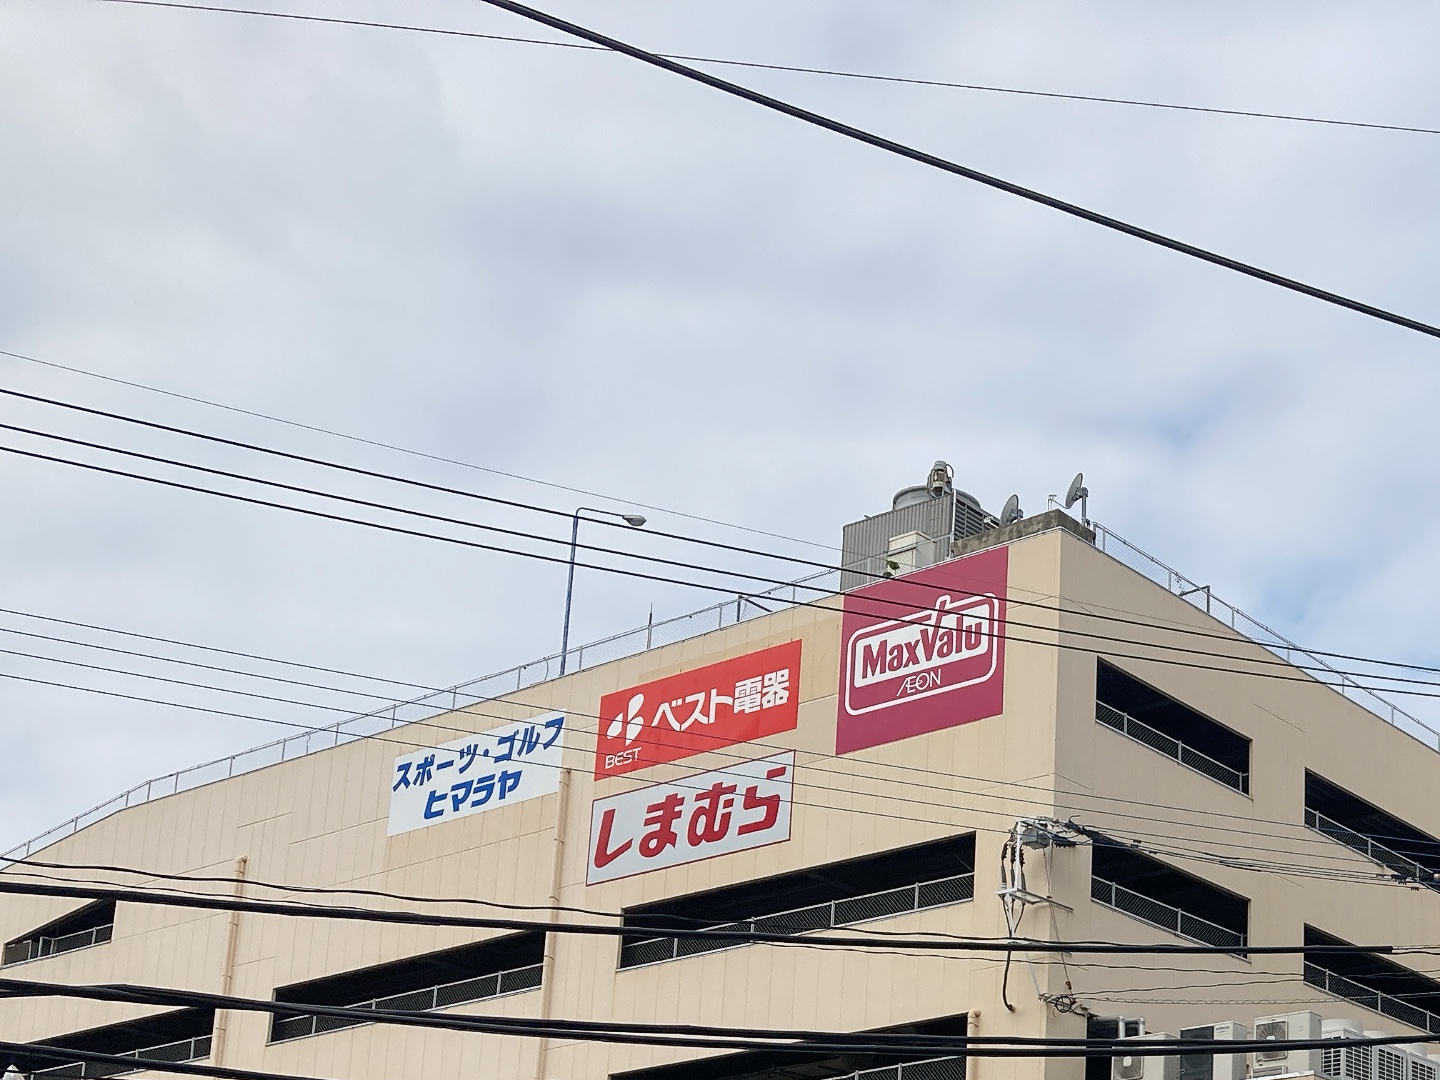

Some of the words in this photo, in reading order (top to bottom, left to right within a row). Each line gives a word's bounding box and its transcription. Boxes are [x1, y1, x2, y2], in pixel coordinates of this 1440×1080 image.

[862, 599, 983, 680] MaxValu
[651, 668, 790, 732] ベスト電器
[392, 716, 566, 792] スポーツ・ゴルフ
[604, 747, 642, 770] BEST
[423, 769, 523, 820] ヒマラヤ
[594, 766, 787, 869] しまむら
